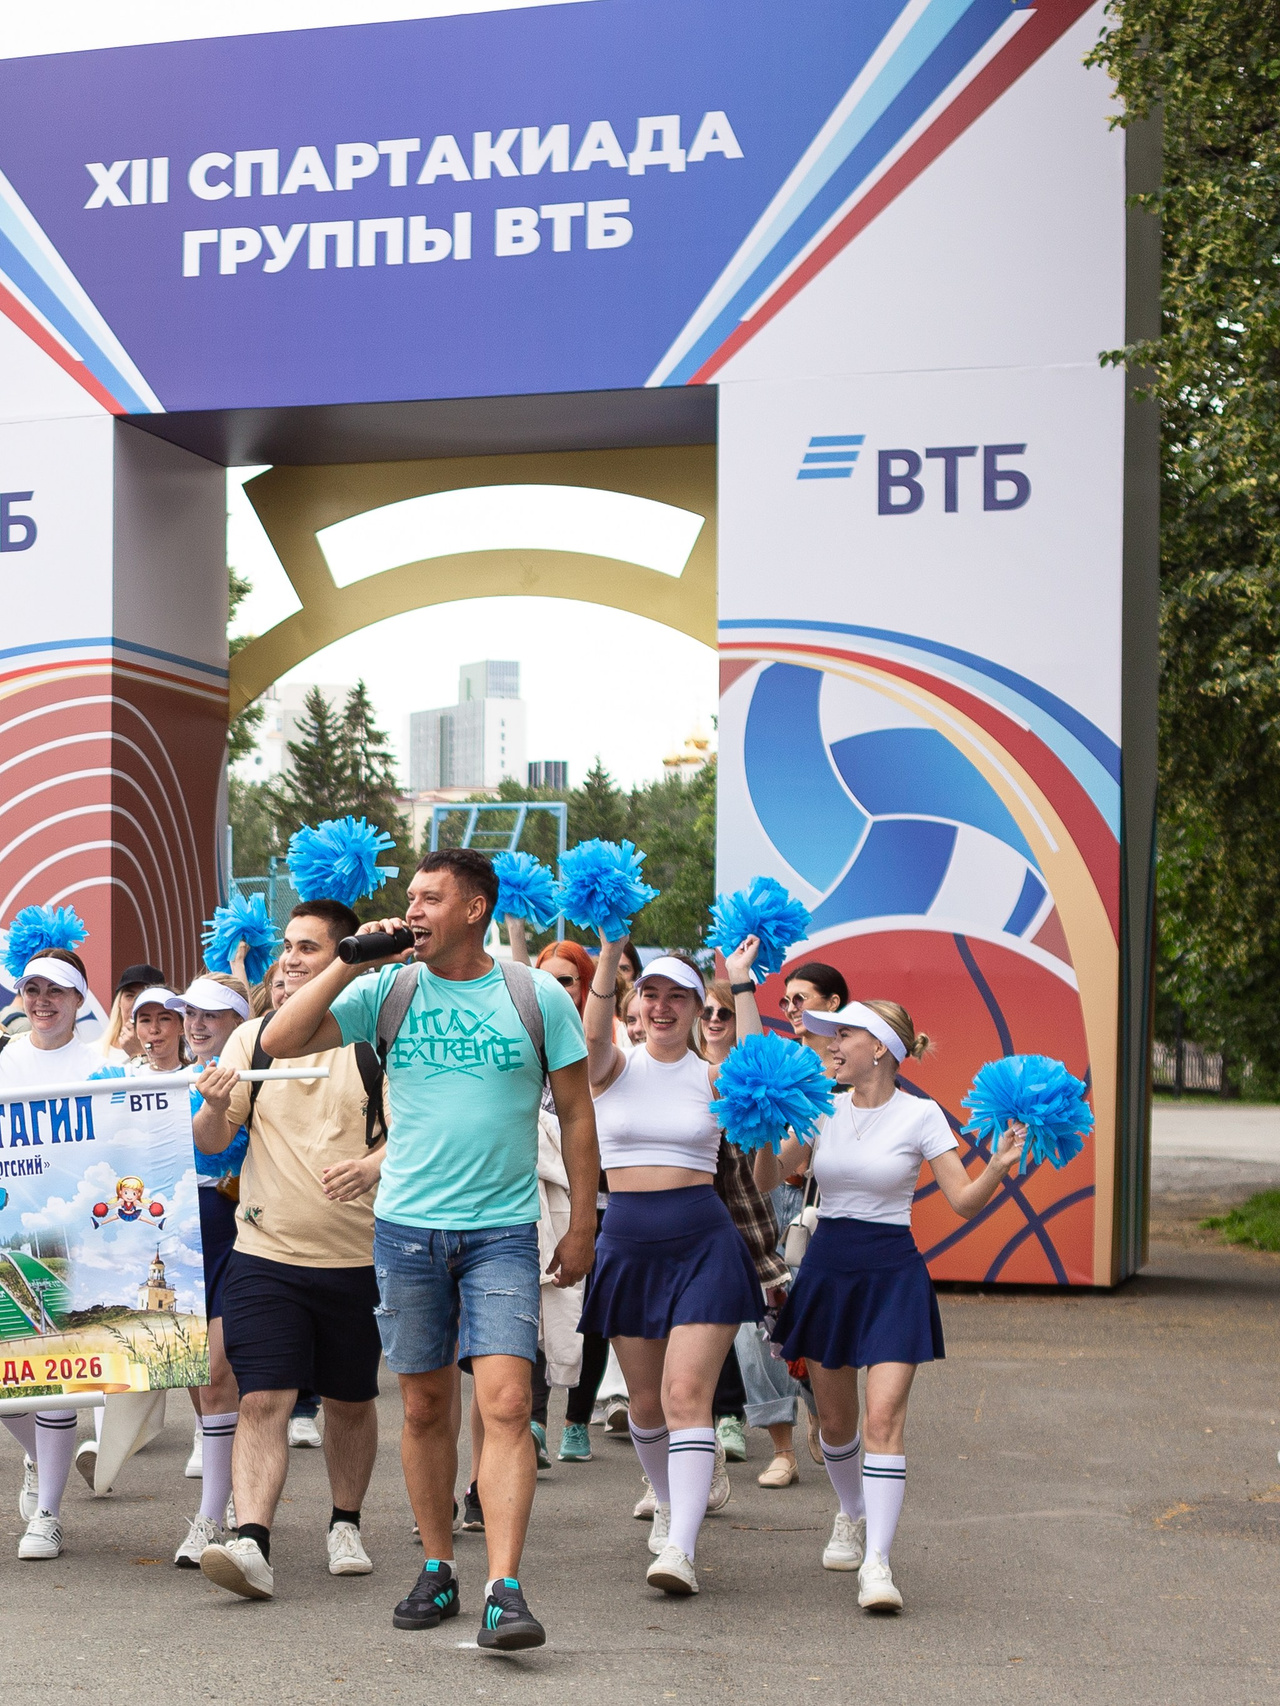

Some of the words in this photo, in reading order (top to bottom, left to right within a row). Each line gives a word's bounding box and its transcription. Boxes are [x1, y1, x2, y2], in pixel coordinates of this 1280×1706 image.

[84, 156, 170, 209] XII
[187, 110, 745, 201] СПАРТАКИАДА
[182, 211, 472, 277] ГРУППЫ
[494, 198, 634, 257] ВТБ
[877, 442, 1033, 516] ВТБ
[392, 1035, 526, 1071] EXTREME
[129, 1092, 169, 1113] ВТБ
[45, 1356, 104, 1381] 2026
